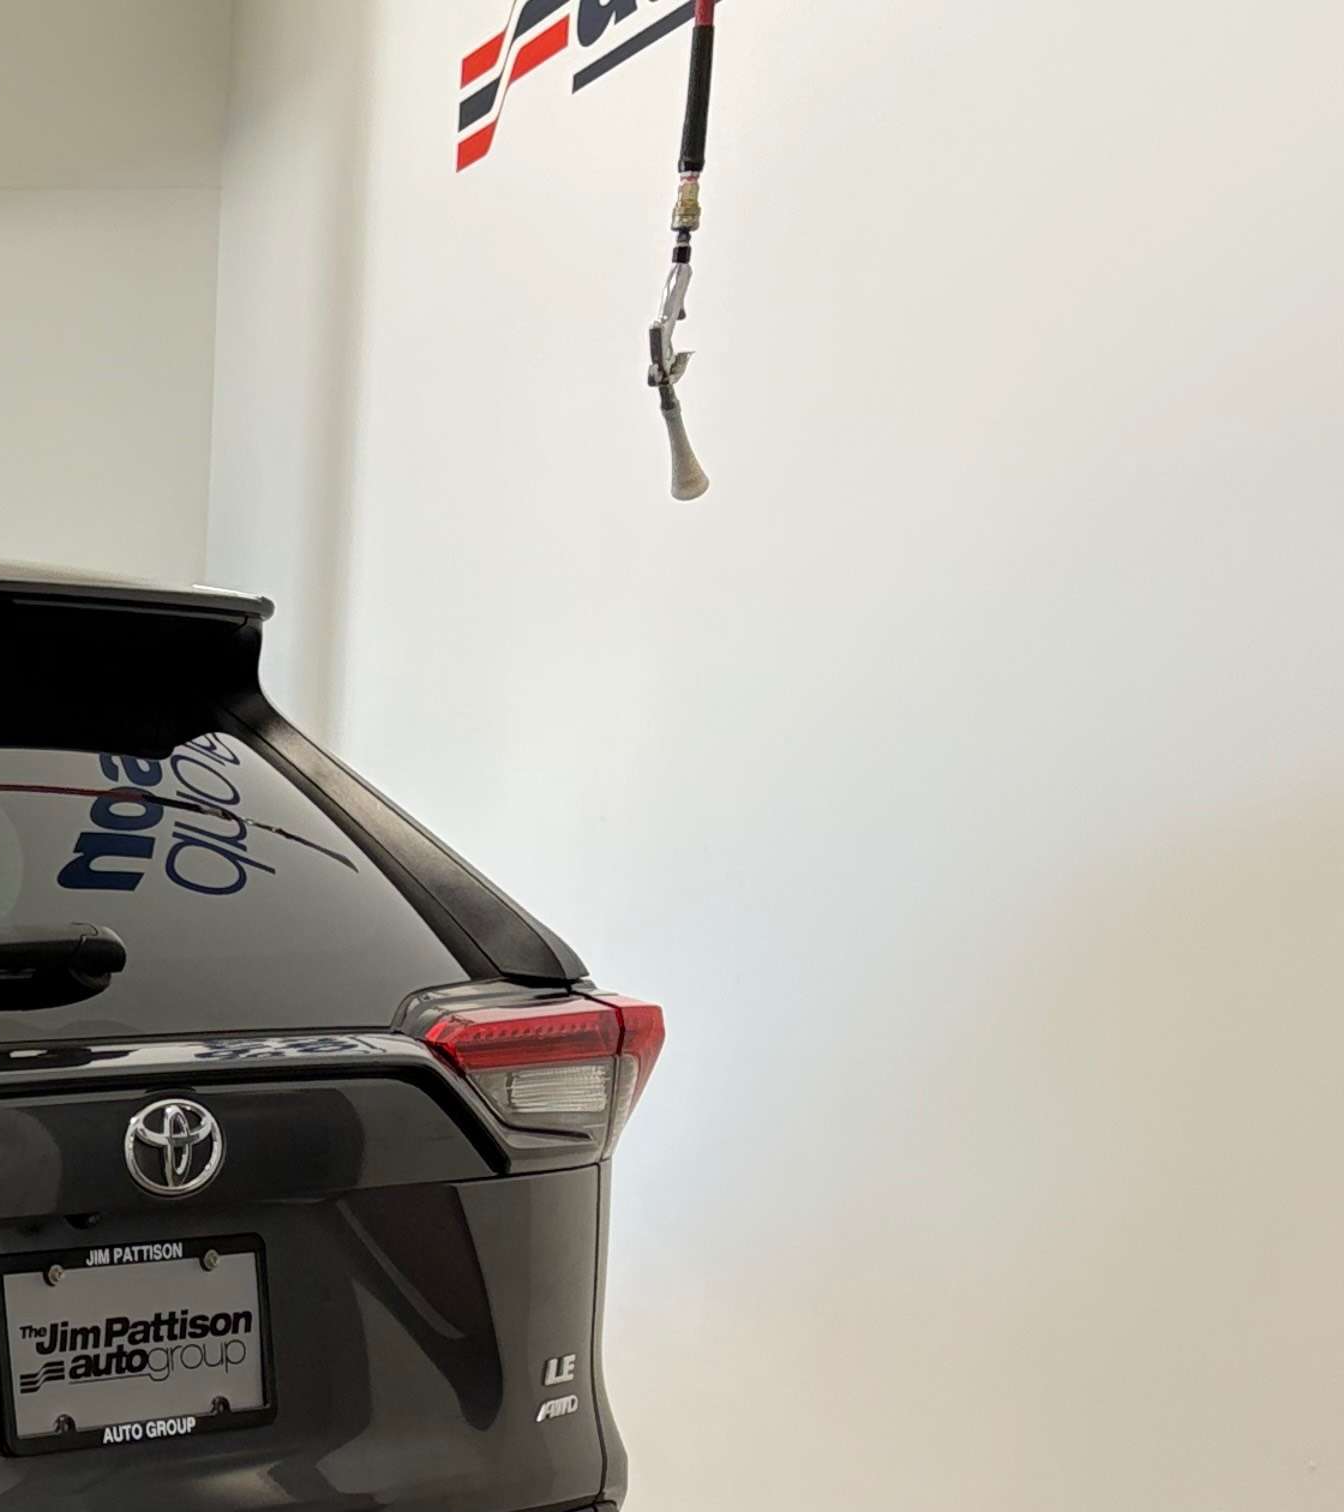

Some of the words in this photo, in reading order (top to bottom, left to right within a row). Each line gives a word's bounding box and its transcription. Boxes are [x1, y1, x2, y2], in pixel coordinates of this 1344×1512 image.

[86, 1248, 110, 1266] JIM
[113, 1242, 183, 1264] PATTISON
[19, 1325, 47, 1339] The
[543, 1354, 576, 1386] LE
[536, 1395, 578, 1422] AWD
[103, 1423, 143, 1444] AUTO
[145, 1416, 196, 1438] GROUP
